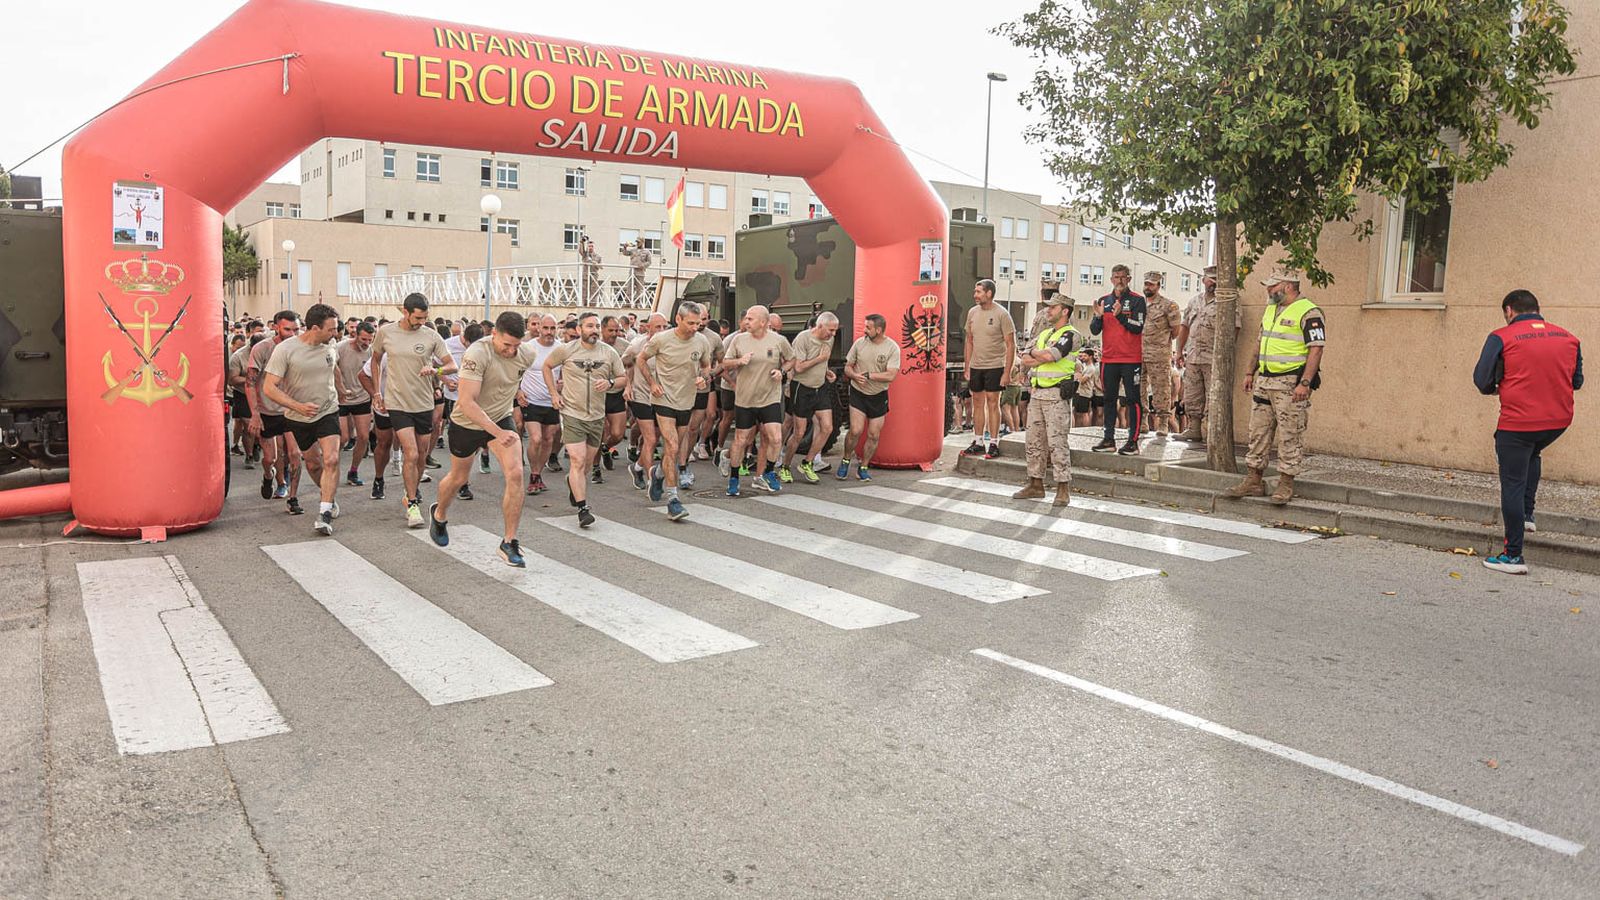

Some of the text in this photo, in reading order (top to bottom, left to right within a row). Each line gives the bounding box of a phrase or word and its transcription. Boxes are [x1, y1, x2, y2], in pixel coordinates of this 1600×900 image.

[434, 27, 768, 90] INFANTERÍA DE MARINA
[384, 51, 804, 137] TERCIO DE ARMADA
[537, 118, 679, 159] SALIDA
[1309, 328, 1325, 341] PN
